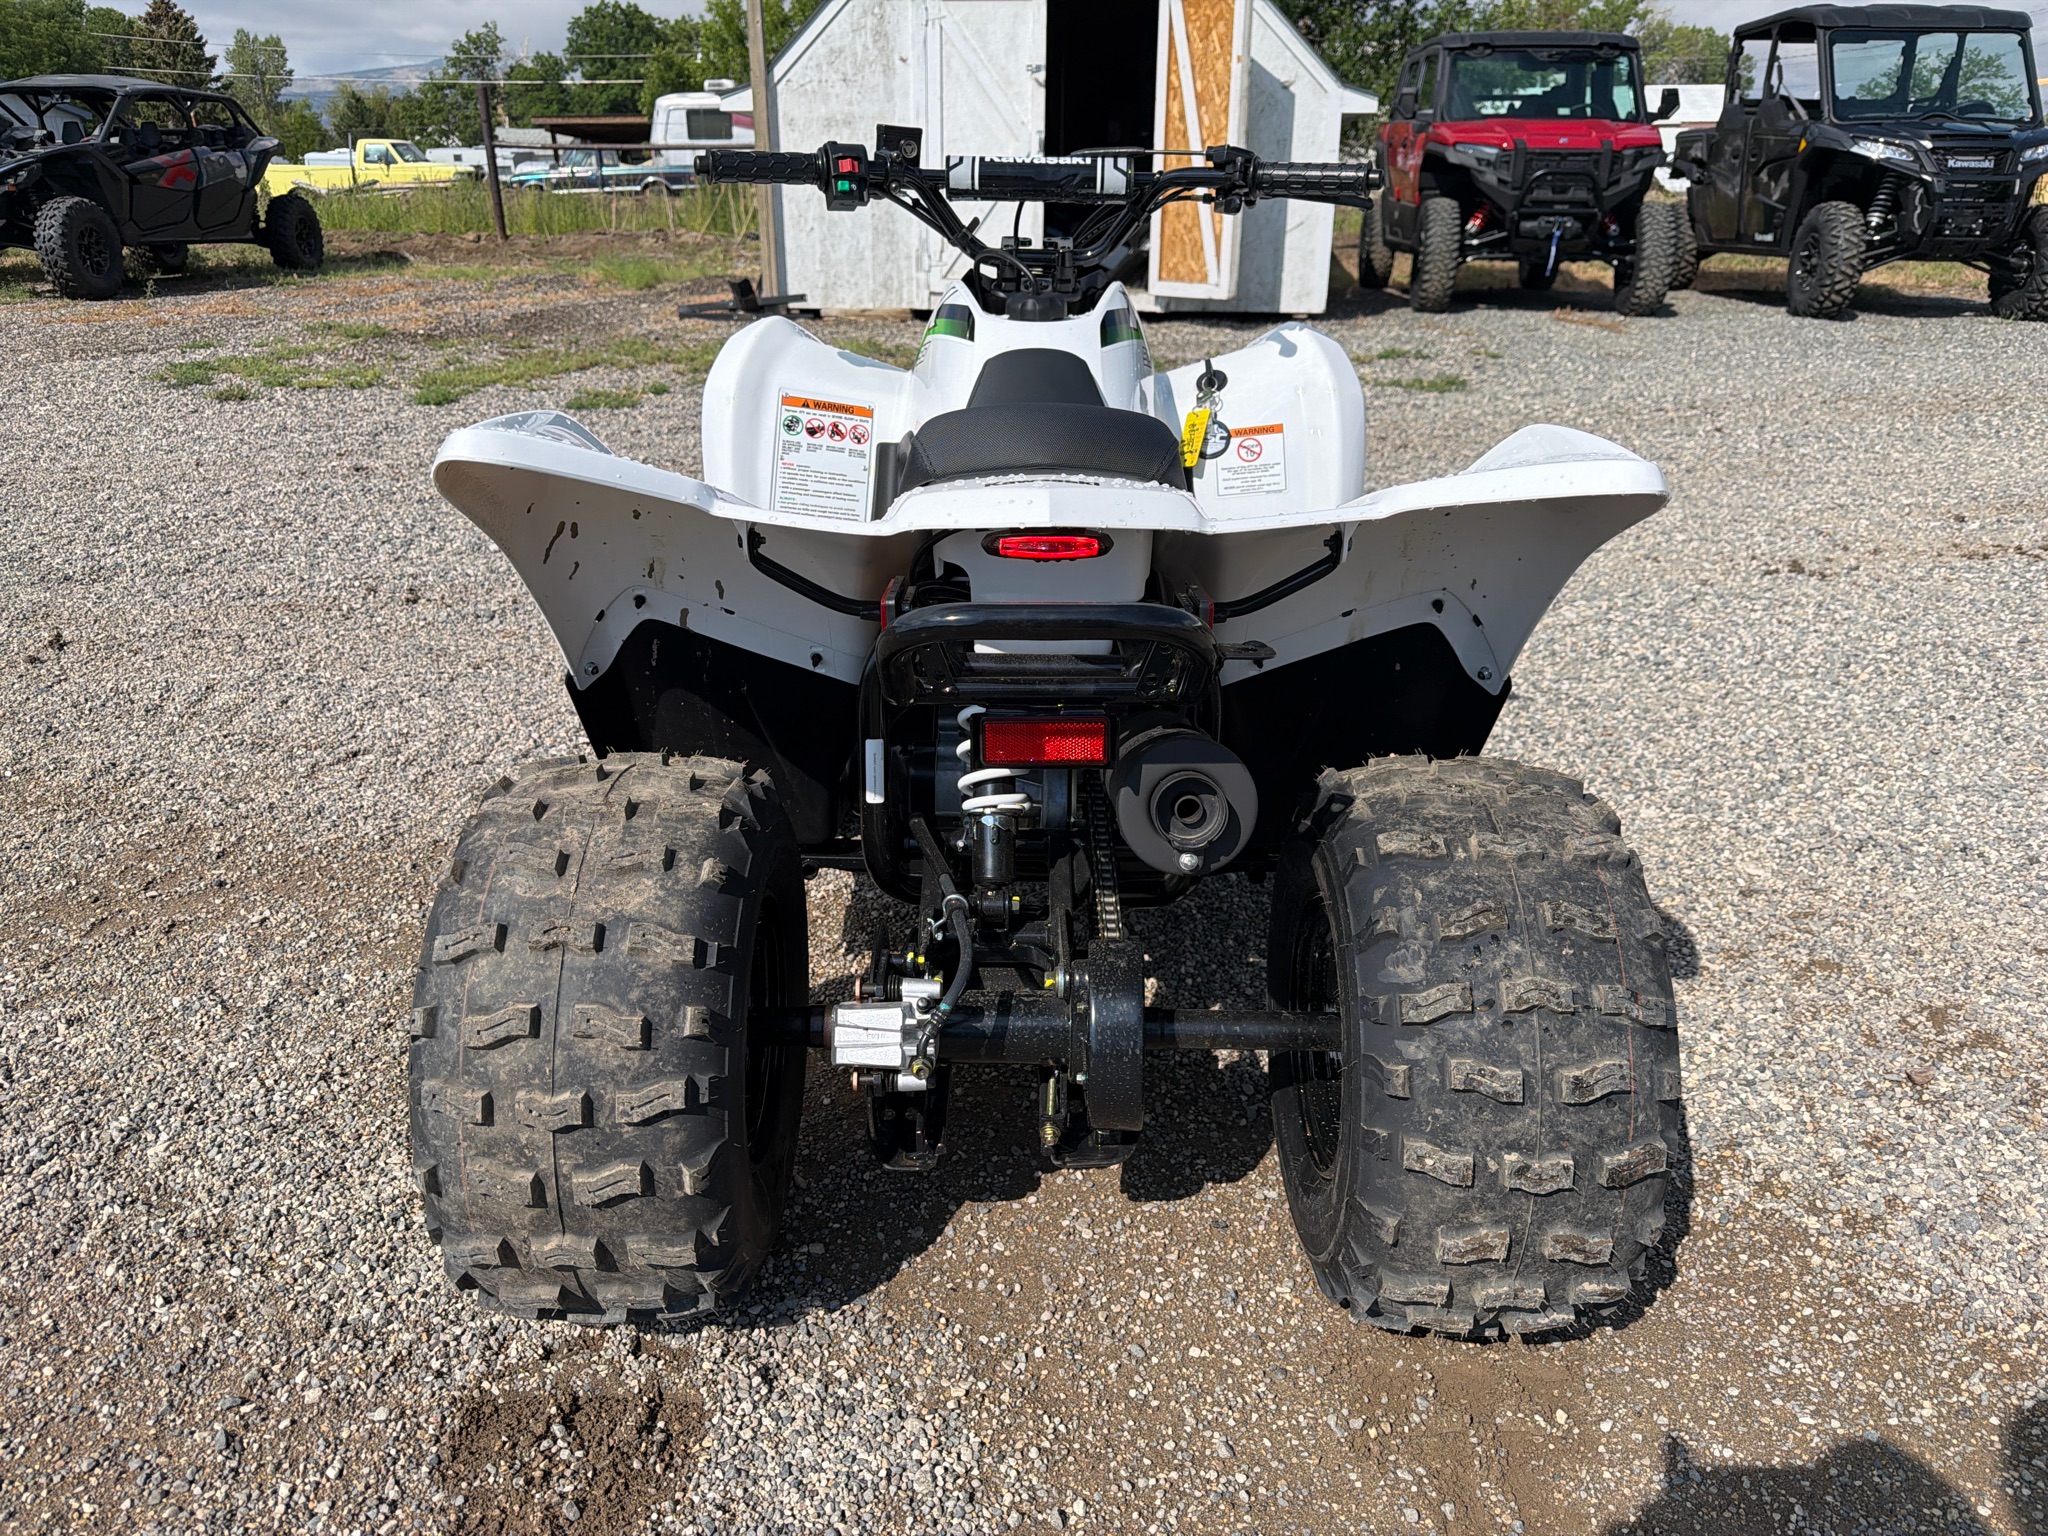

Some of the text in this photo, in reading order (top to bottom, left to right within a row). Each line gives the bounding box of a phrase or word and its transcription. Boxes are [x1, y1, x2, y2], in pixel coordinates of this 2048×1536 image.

[984, 156, 1092, 165] Kawasaki
[1947, 159, 1995, 169] Kawasaki
[813, 402, 854, 414] WARNING
[1235, 426, 1275, 436] WARNING
[1245, 450, 1255, 458] 10
